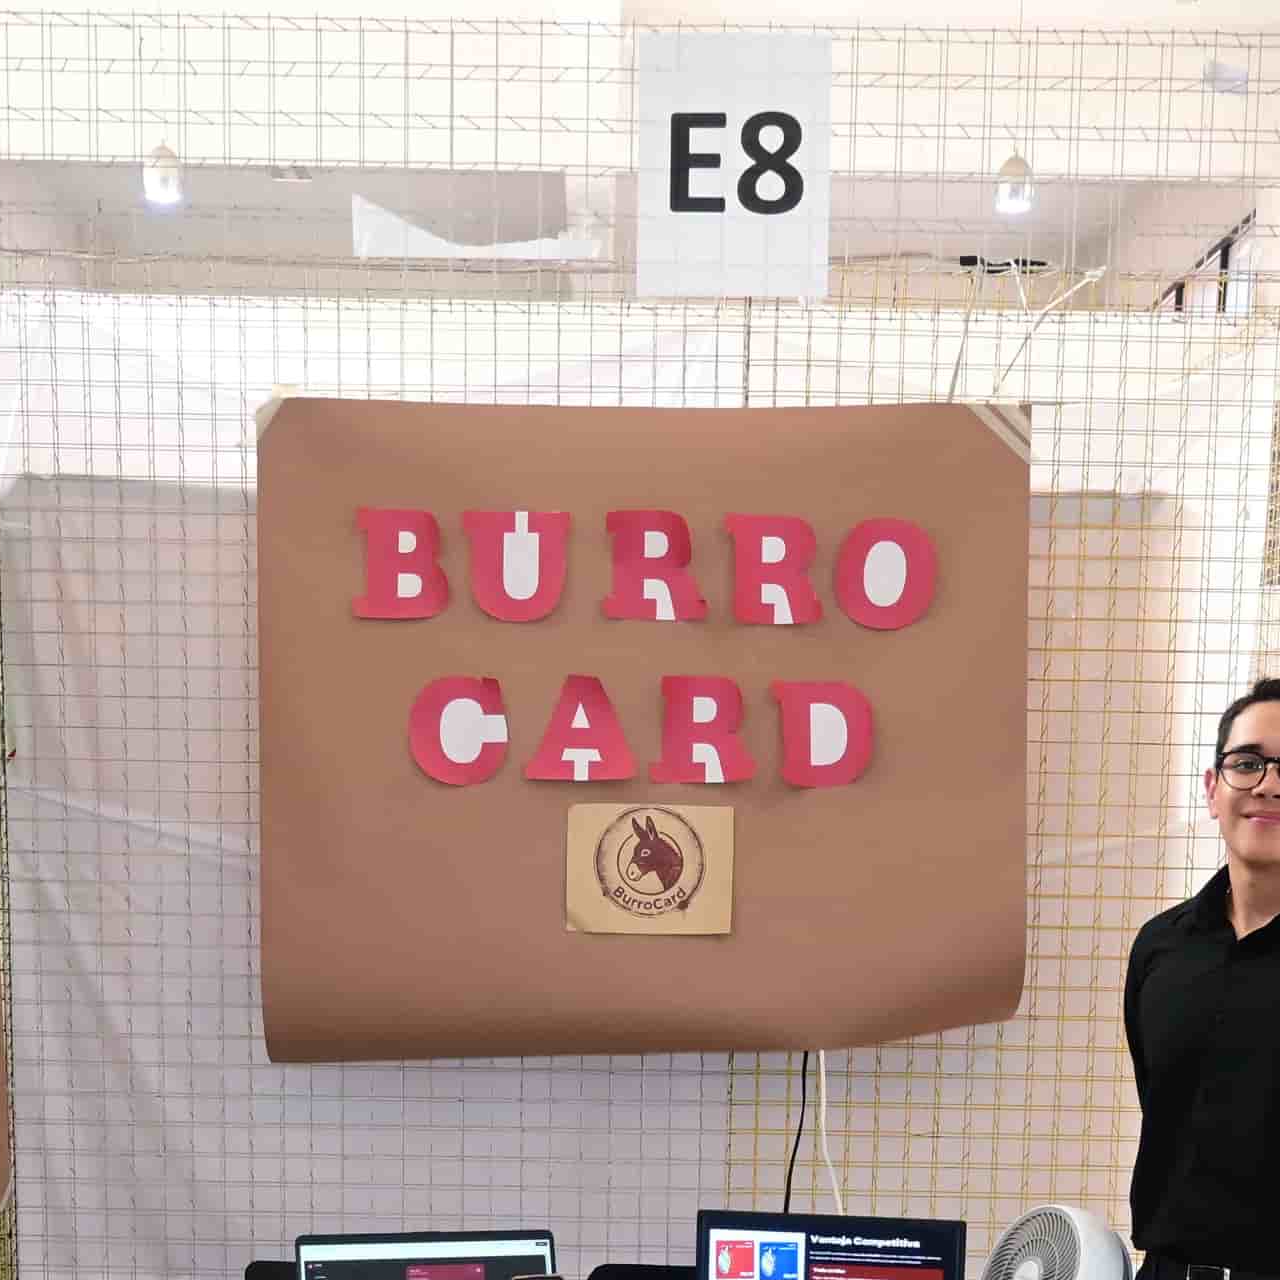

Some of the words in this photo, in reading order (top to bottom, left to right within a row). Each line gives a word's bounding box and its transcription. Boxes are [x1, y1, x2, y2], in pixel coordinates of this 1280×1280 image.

[670, 111, 804, 214] E8
[352, 507, 938, 631] BURRO
[408, 674, 875, 788] CARD
[613, 886, 686, 910] BurroCard
